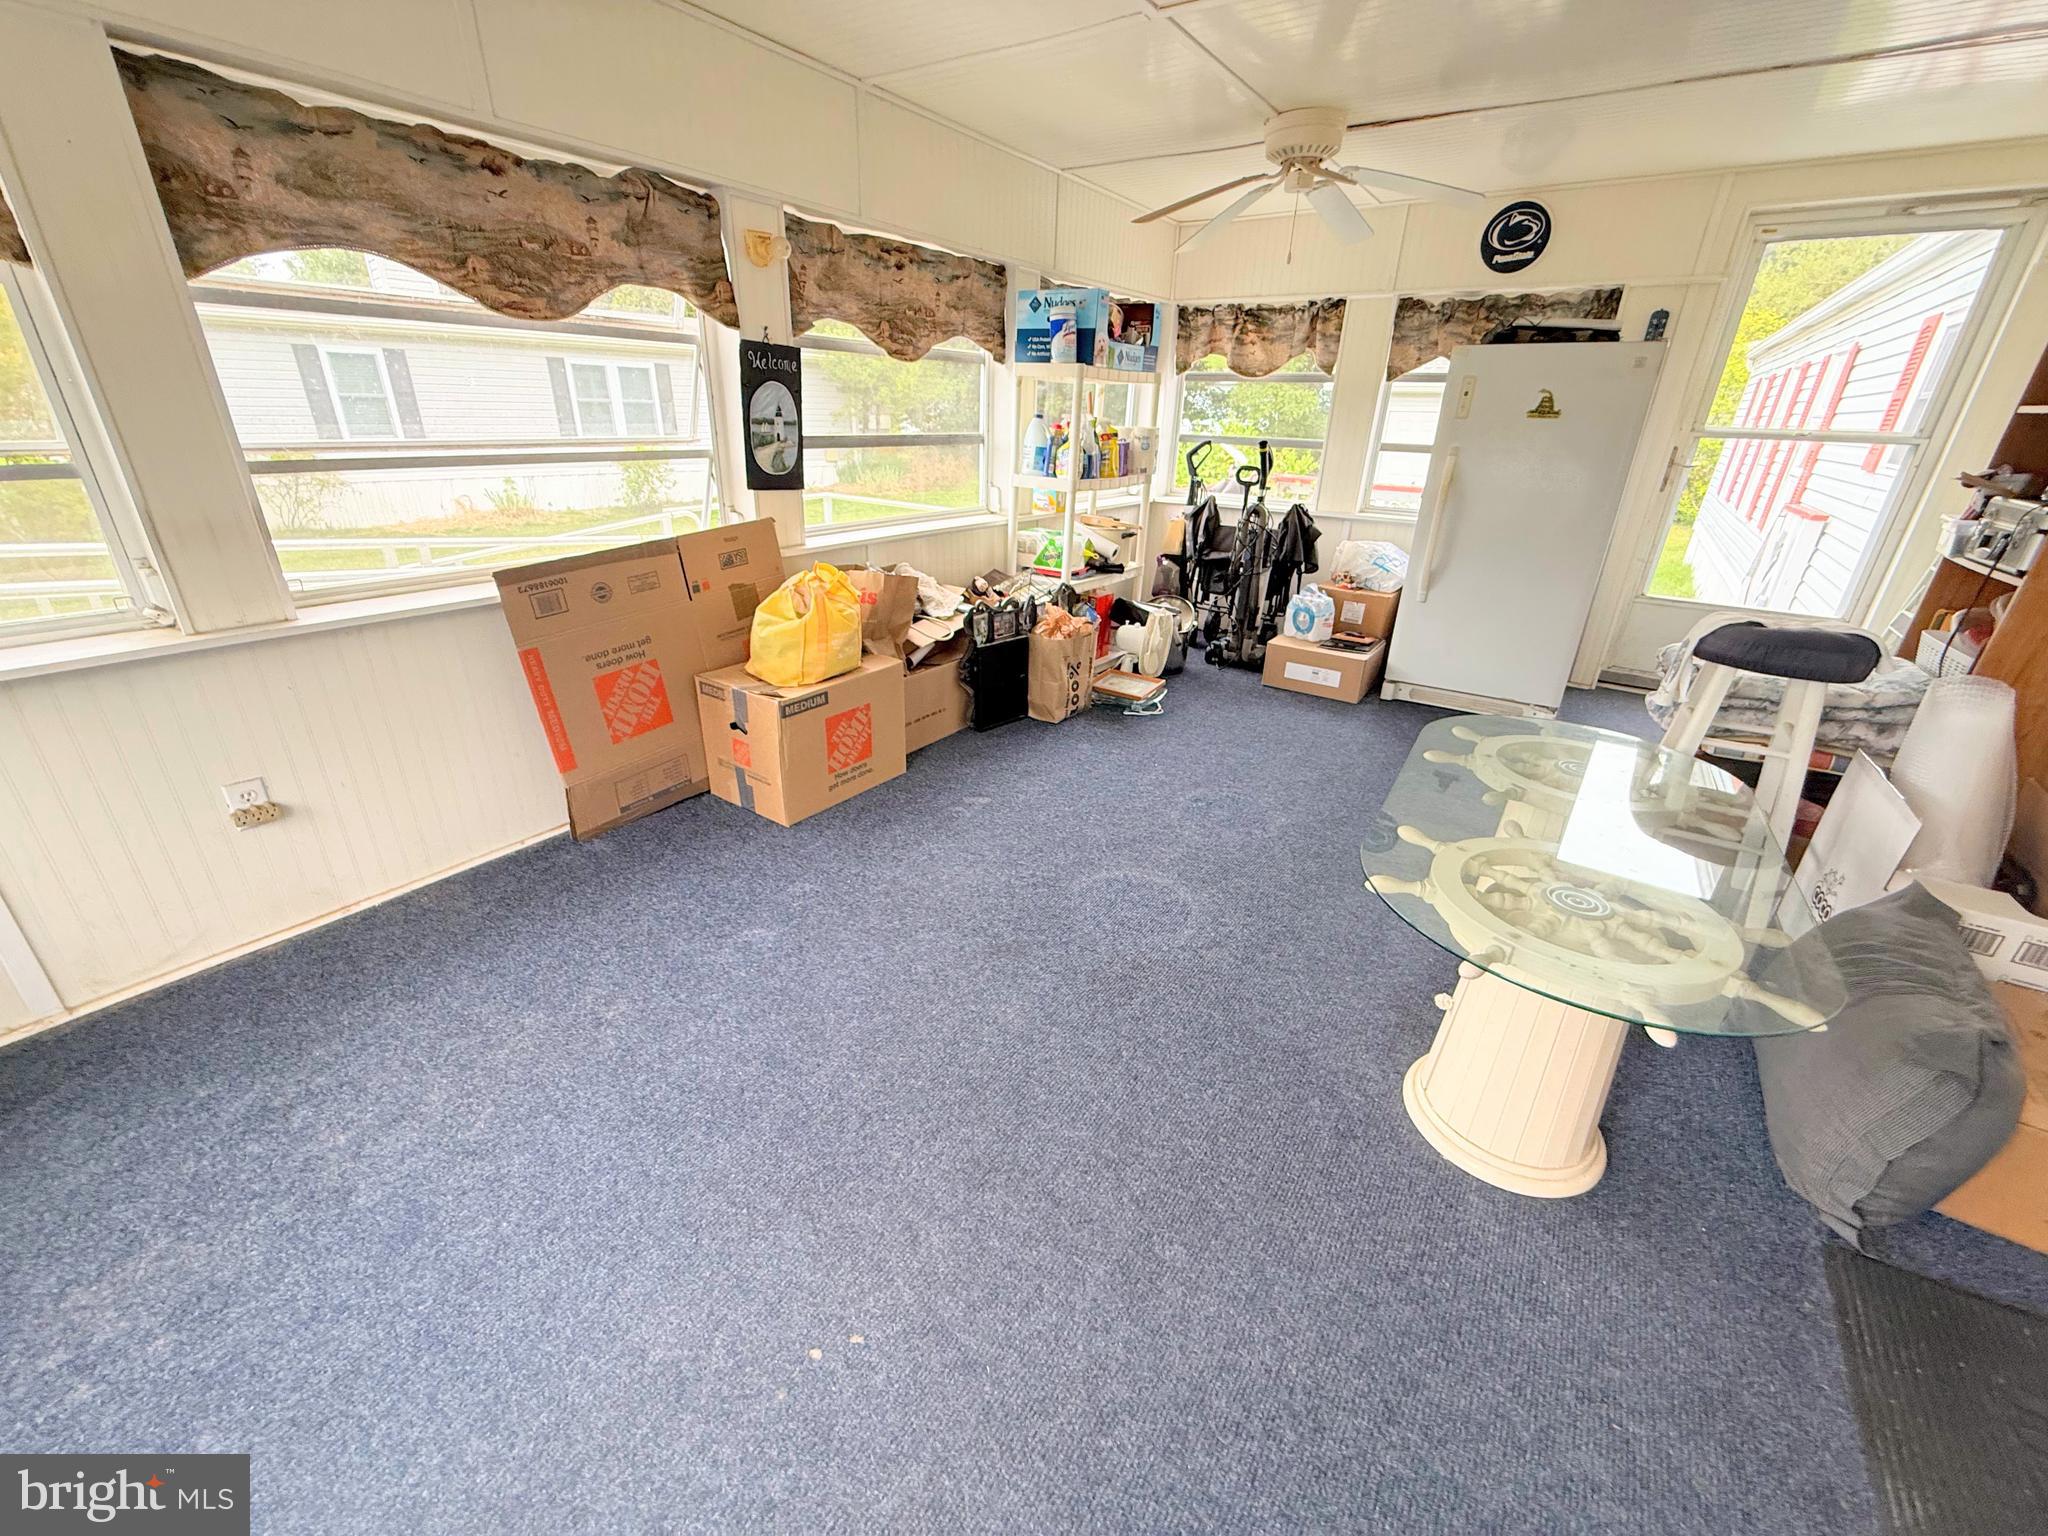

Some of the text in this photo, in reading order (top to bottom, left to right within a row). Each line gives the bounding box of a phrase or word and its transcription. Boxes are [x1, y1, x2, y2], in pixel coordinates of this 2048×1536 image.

[748, 350, 798, 372] Welcome
[611, 642, 636, 654] more
[638, 635, 652, 648] get
[596, 650, 646, 669] How doers
[785, 694, 826, 716] MEDIUM
[828, 707, 871, 770] HOME
